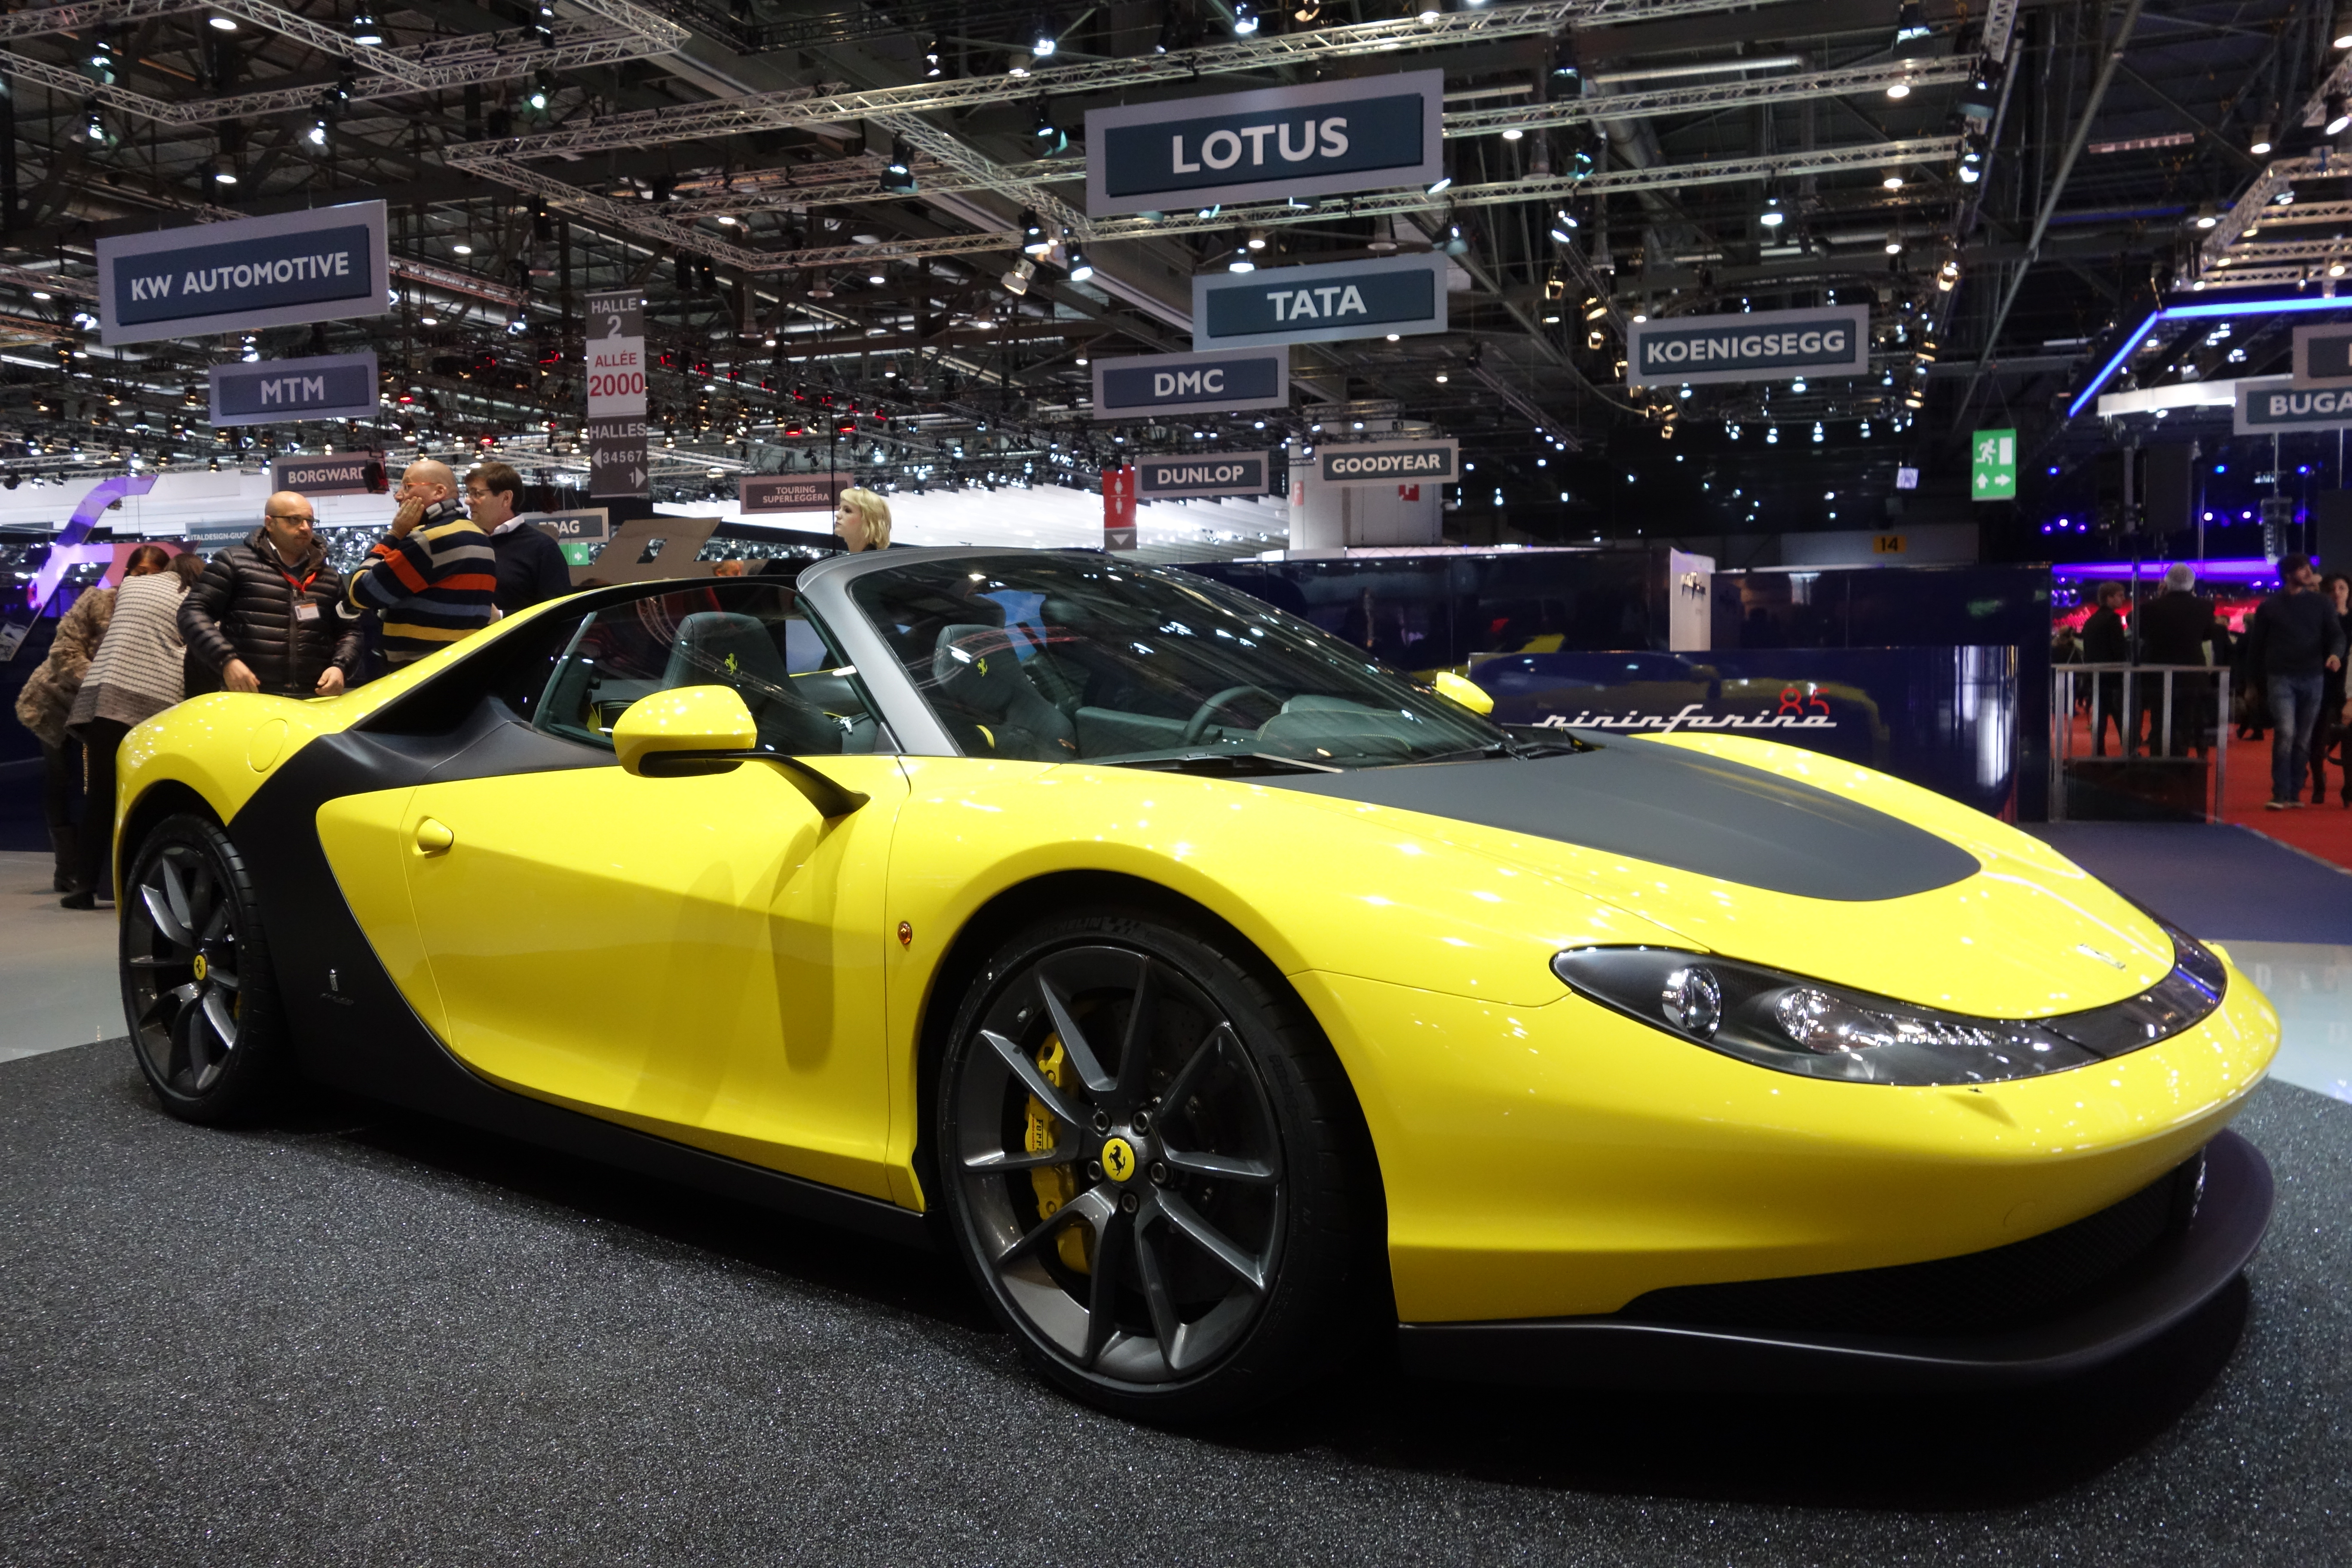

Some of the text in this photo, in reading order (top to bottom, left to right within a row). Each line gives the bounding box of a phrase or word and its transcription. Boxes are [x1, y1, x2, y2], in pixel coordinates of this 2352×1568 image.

[1173, 116, 1350, 174] LOTUS
[131, 251, 350, 301] KW AUTOMOTIVE
[591, 297, 637, 314] HALLE
[1267, 284, 1367, 322] TATA
[607, 315, 622, 339] 2
[1647, 330, 1846, 364] KOENIGSEGG
[595, 350, 637, 368] ALLÉE
[260, 375, 325, 405] MTM
[589, 372, 644, 397] 2000
[1154, 369, 1225, 397] DMC
[2269, 392, 2352, 416] BUGA
[589, 423, 646, 439] HALLES
[1331, 453, 1442, 473] GOODYEAR
[628, 471, 634, 484] 1
[1157, 465, 1244, 485] DUNLOP
[762, 493, 830, 504] SUPERLEGGERA
[775, 485, 816, 495] TOURING
[191, 531, 249, 541] ITALDESIGN-GIUG
[1879, 537, 1899, 551] 14
[1778, 688, 1830, 715] 85
